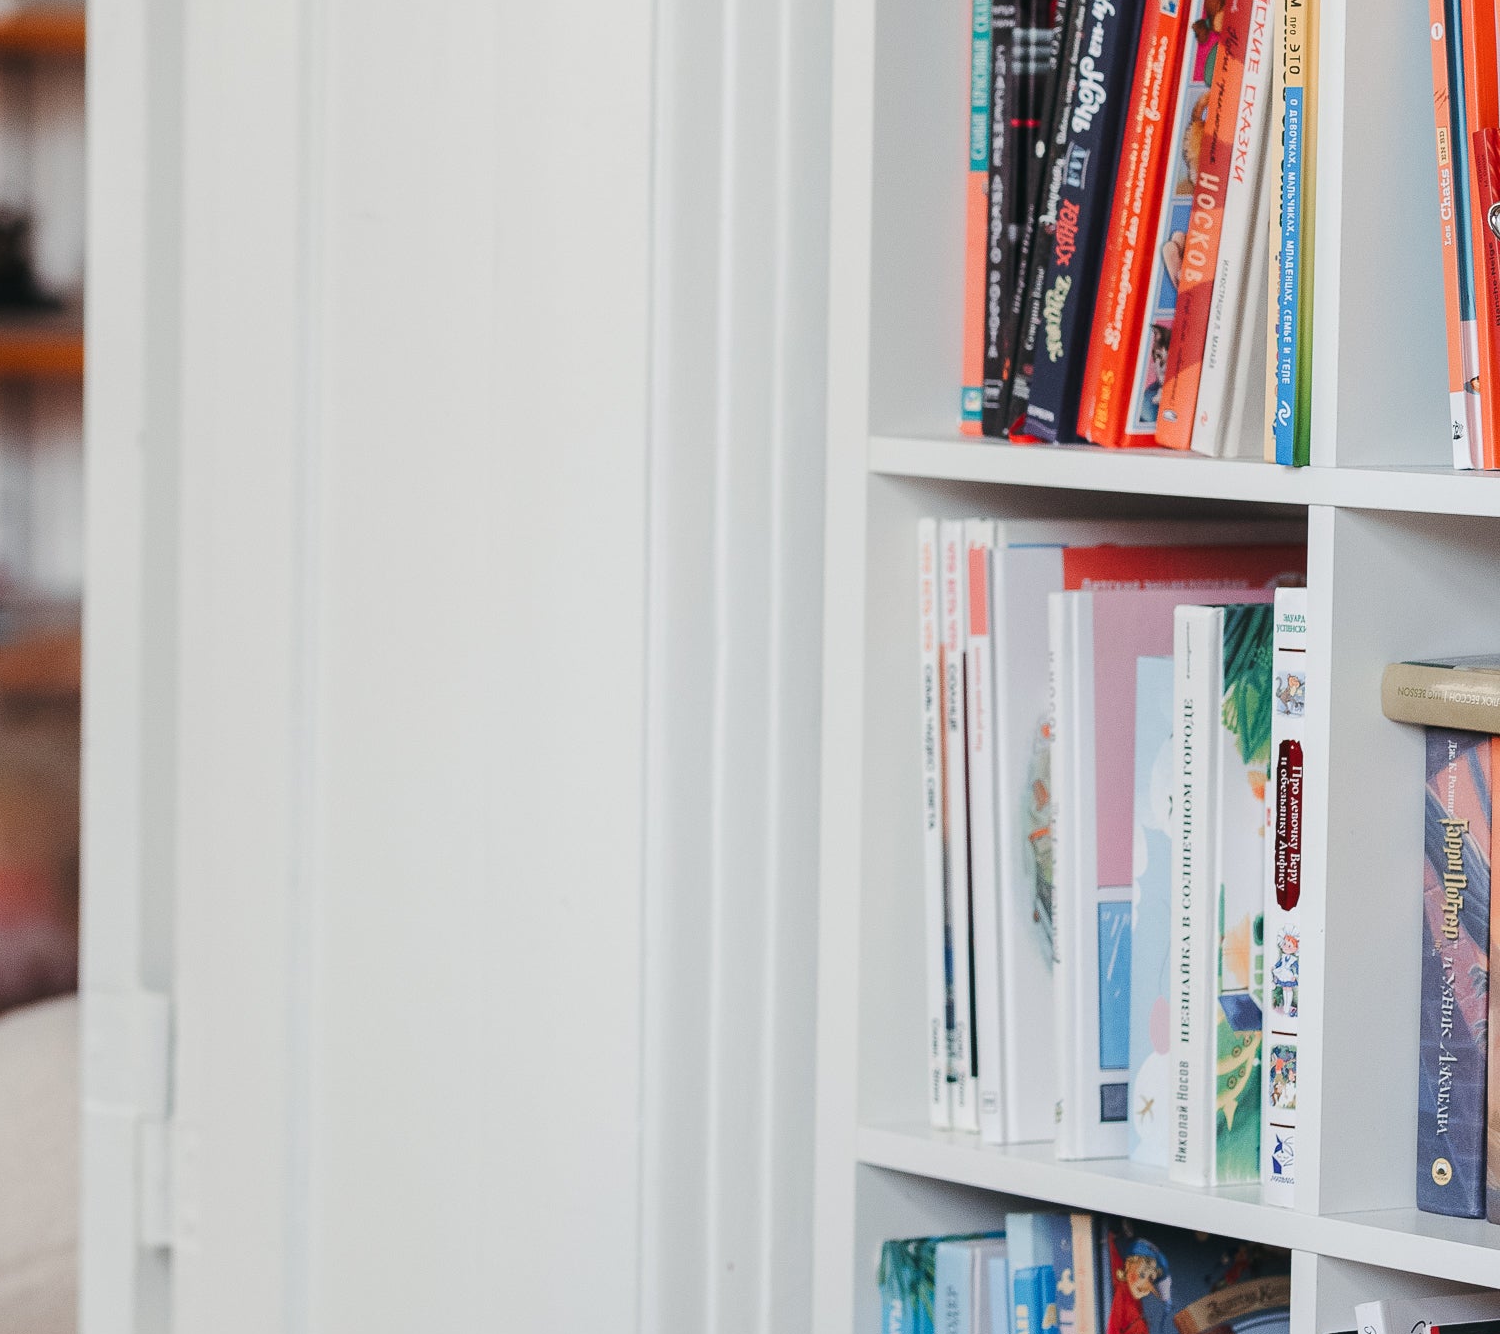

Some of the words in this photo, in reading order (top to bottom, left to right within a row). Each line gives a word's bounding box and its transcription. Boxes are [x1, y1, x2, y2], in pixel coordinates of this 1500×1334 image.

[1289, 43, 1301, 76] ЭТО
[1289, 98, 1298, 106] О
[1232, 83, 1257, 184] СКАЗКИ
[1288, 109, 1298, 168] ДЕВОЧКАХ,
[1438, 130, 1445, 145] BD
[1439, 146, 1447, 161] EN
[1131, 125, 1153, 215] animaux
[1285, 171, 1296, 236] МАЛЬЧИКАХ,
[1440, 168, 1452, 221] Chats
[1186, 171, 1220, 283] НОСКОВ
[1283, 240, 1295, 306] МЛАДЕНЦАХ,
[1283, 308, 1293, 344] СЕМЬЕ
[1281, 356, 1291, 385] ТЕЛЕ
[1283, 613, 1306, 623] ЭДУАРД
[1398, 685, 1427, 698] BESSON
[1449, 691, 1480, 706] БЕССОН
[1183, 699, 1193, 777] ГОРОДЕ
[1280, 757, 1287, 765] и
[1448, 740, 1457, 760] Дж.
[1291, 765, 1303, 797] Про
[1448, 763, 1457, 773] К.
[1277, 767, 1289, 838] обезьянку
[1288, 797, 1299, 850] девочку
[1181, 789, 1193, 910] СОЛНЕЧНОМ
[1276, 840, 1288, 892] Анфису
[1438, 818, 1470, 872] Гарри
[1287, 853, 1301, 885] Веру
[1181, 916, 1192, 927] В
[1441, 872, 1468, 940] Поттер
[1180, 934, 1191, 1043] НЕЗНАЙКА
[1177, 1060, 1190, 1101] Носов
[1175, 1105, 1189, 1163] Николай
